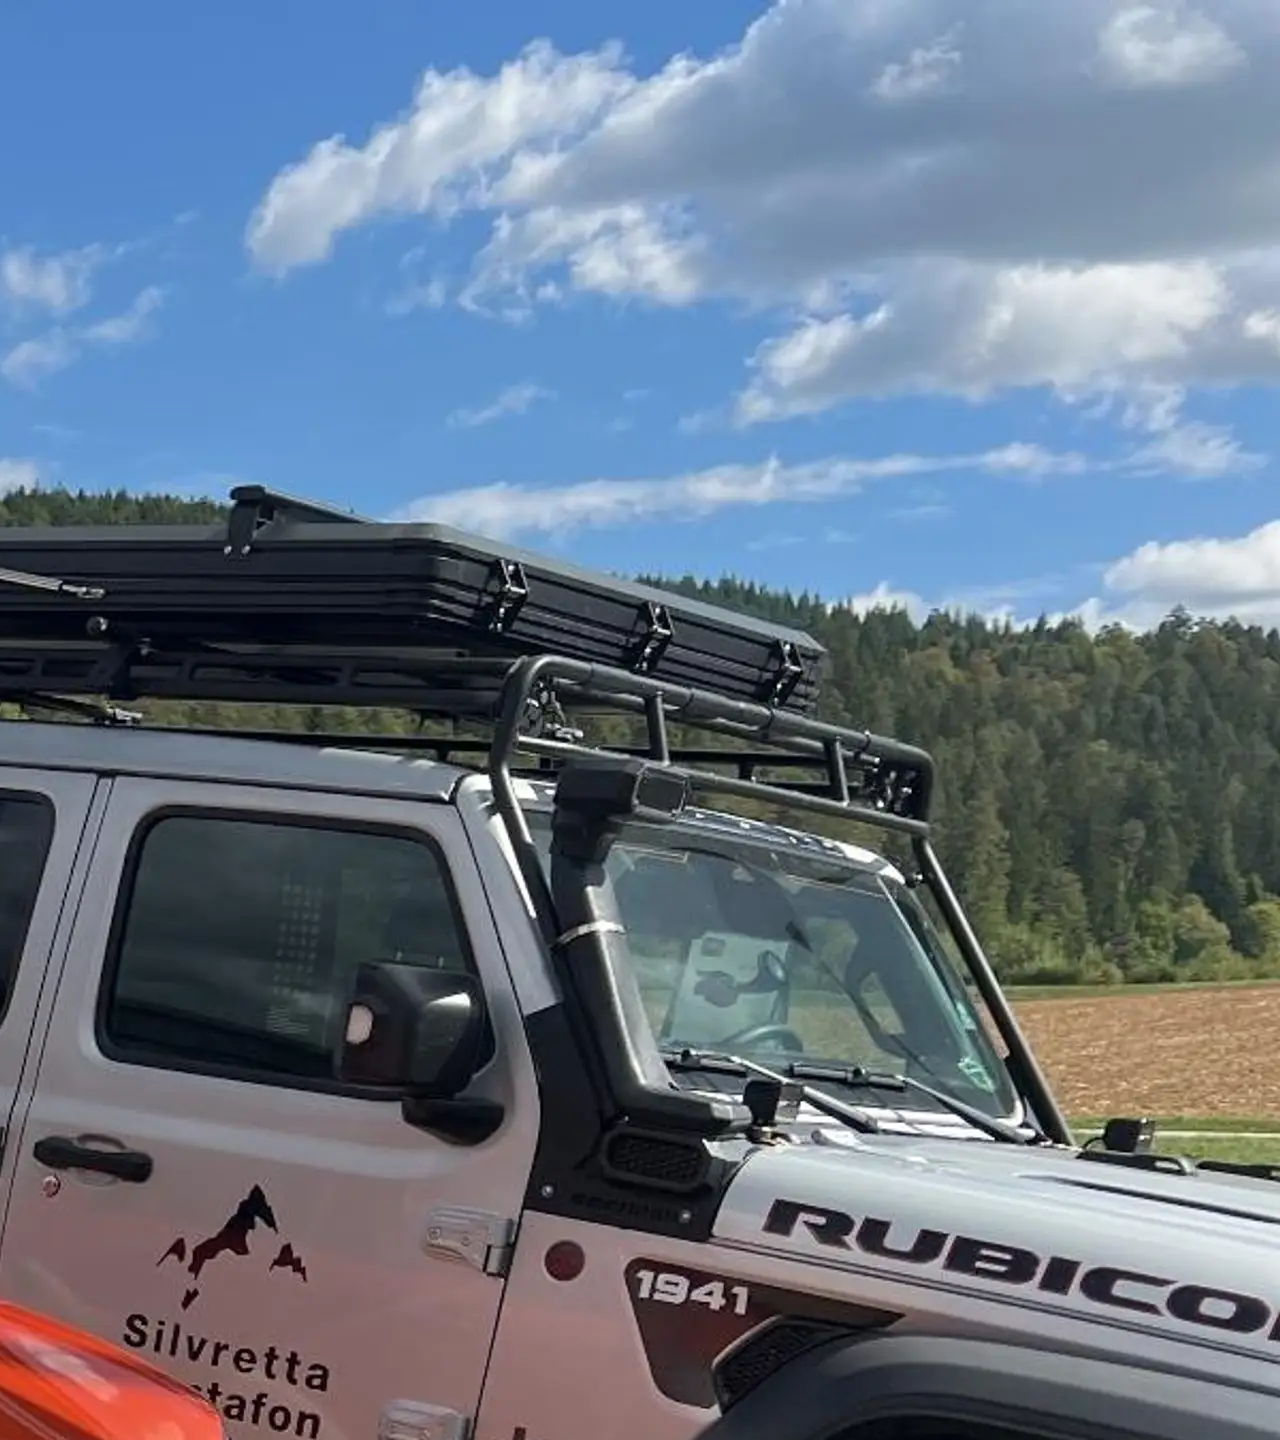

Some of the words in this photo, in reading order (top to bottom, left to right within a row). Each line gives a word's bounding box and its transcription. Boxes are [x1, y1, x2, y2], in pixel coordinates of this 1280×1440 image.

[636, 1269, 749, 1316] 1941
[762, 1198, 1280, 1342] RUBICO
[122, 1313, 330, 1392] Silvretta
[191, 1382, 322, 1440] tafon
